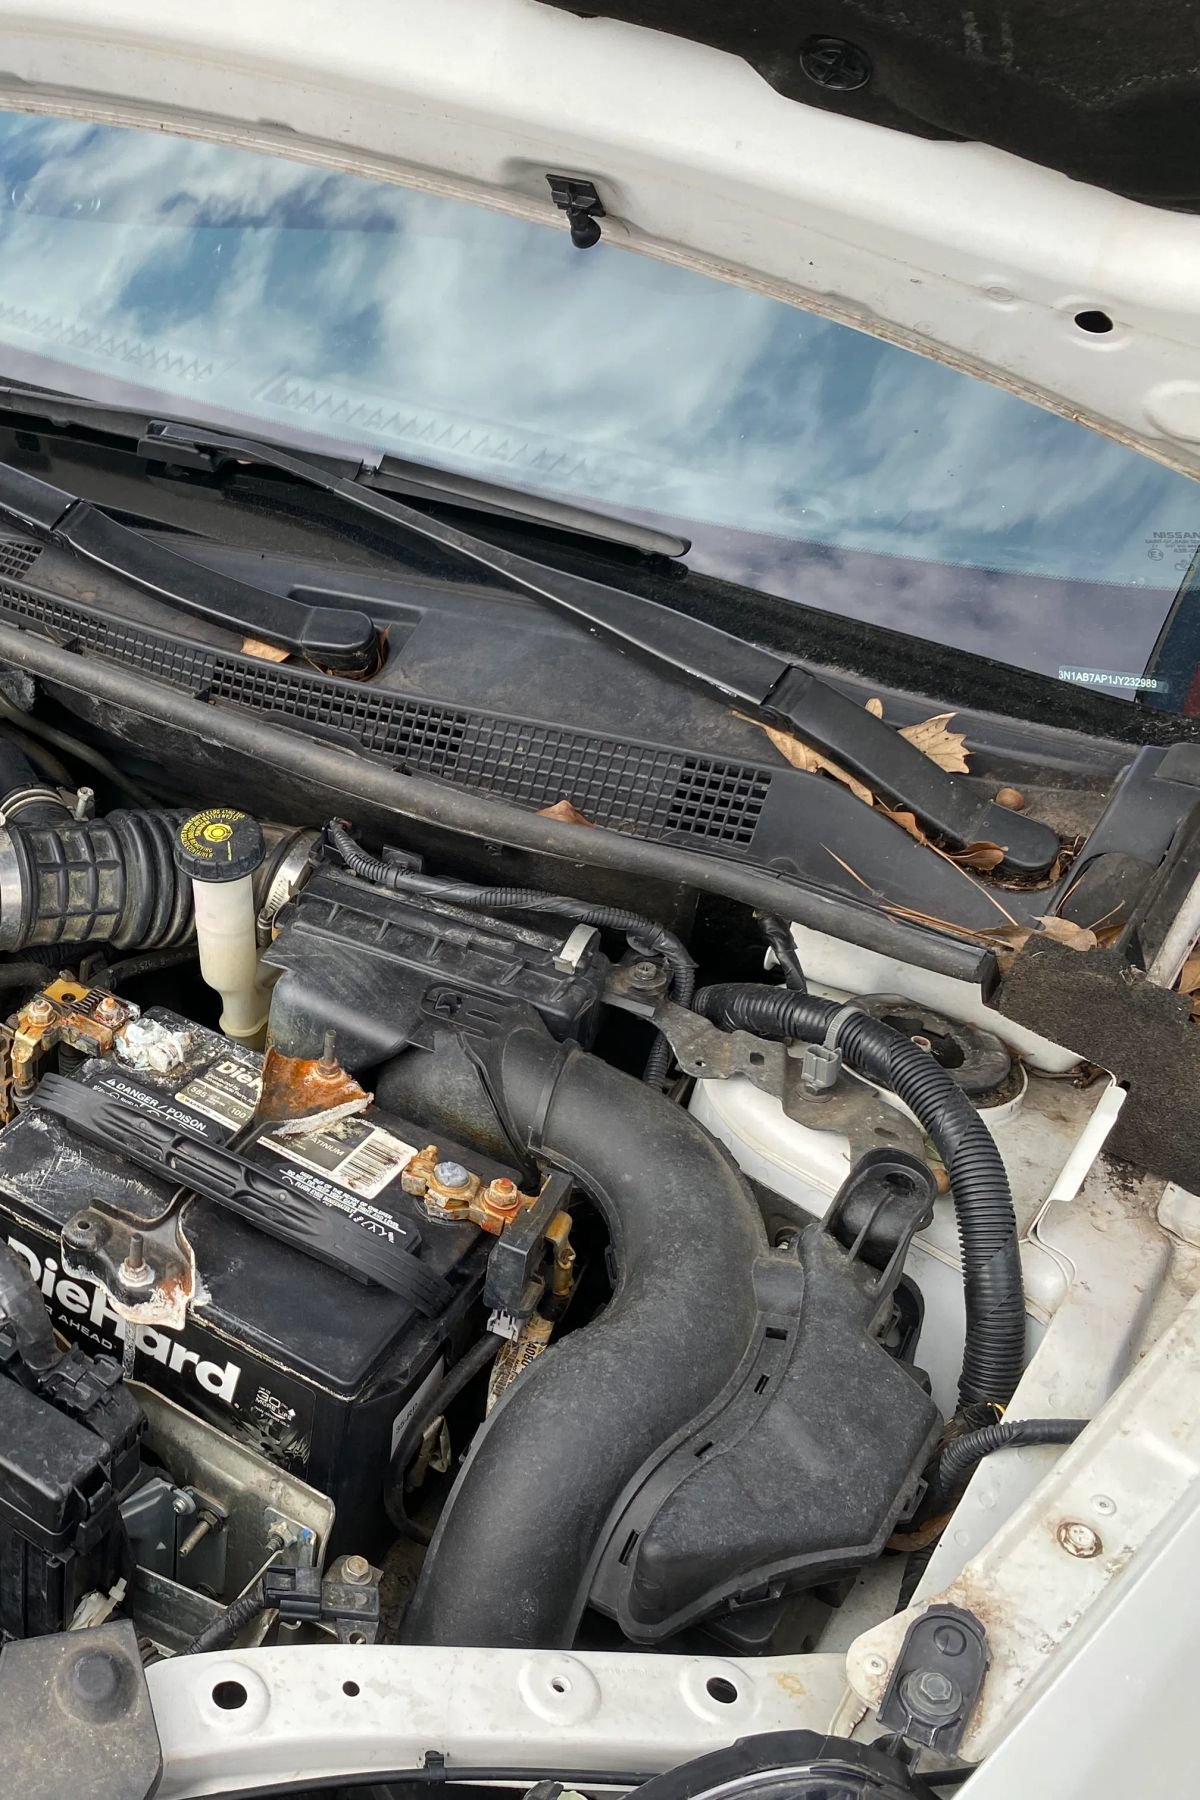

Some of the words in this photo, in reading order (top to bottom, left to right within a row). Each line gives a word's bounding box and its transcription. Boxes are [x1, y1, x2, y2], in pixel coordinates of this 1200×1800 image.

[117, 1082, 158, 1106] DANGER
[166, 1107, 207, 1131] POISON
[230, 1107, 246, 1119] 100
[58, 1313, 114, 1350] AHEAD
[254, 1397, 276, 1411] MORE
[276, 1409, 292, 1421] LIFE
